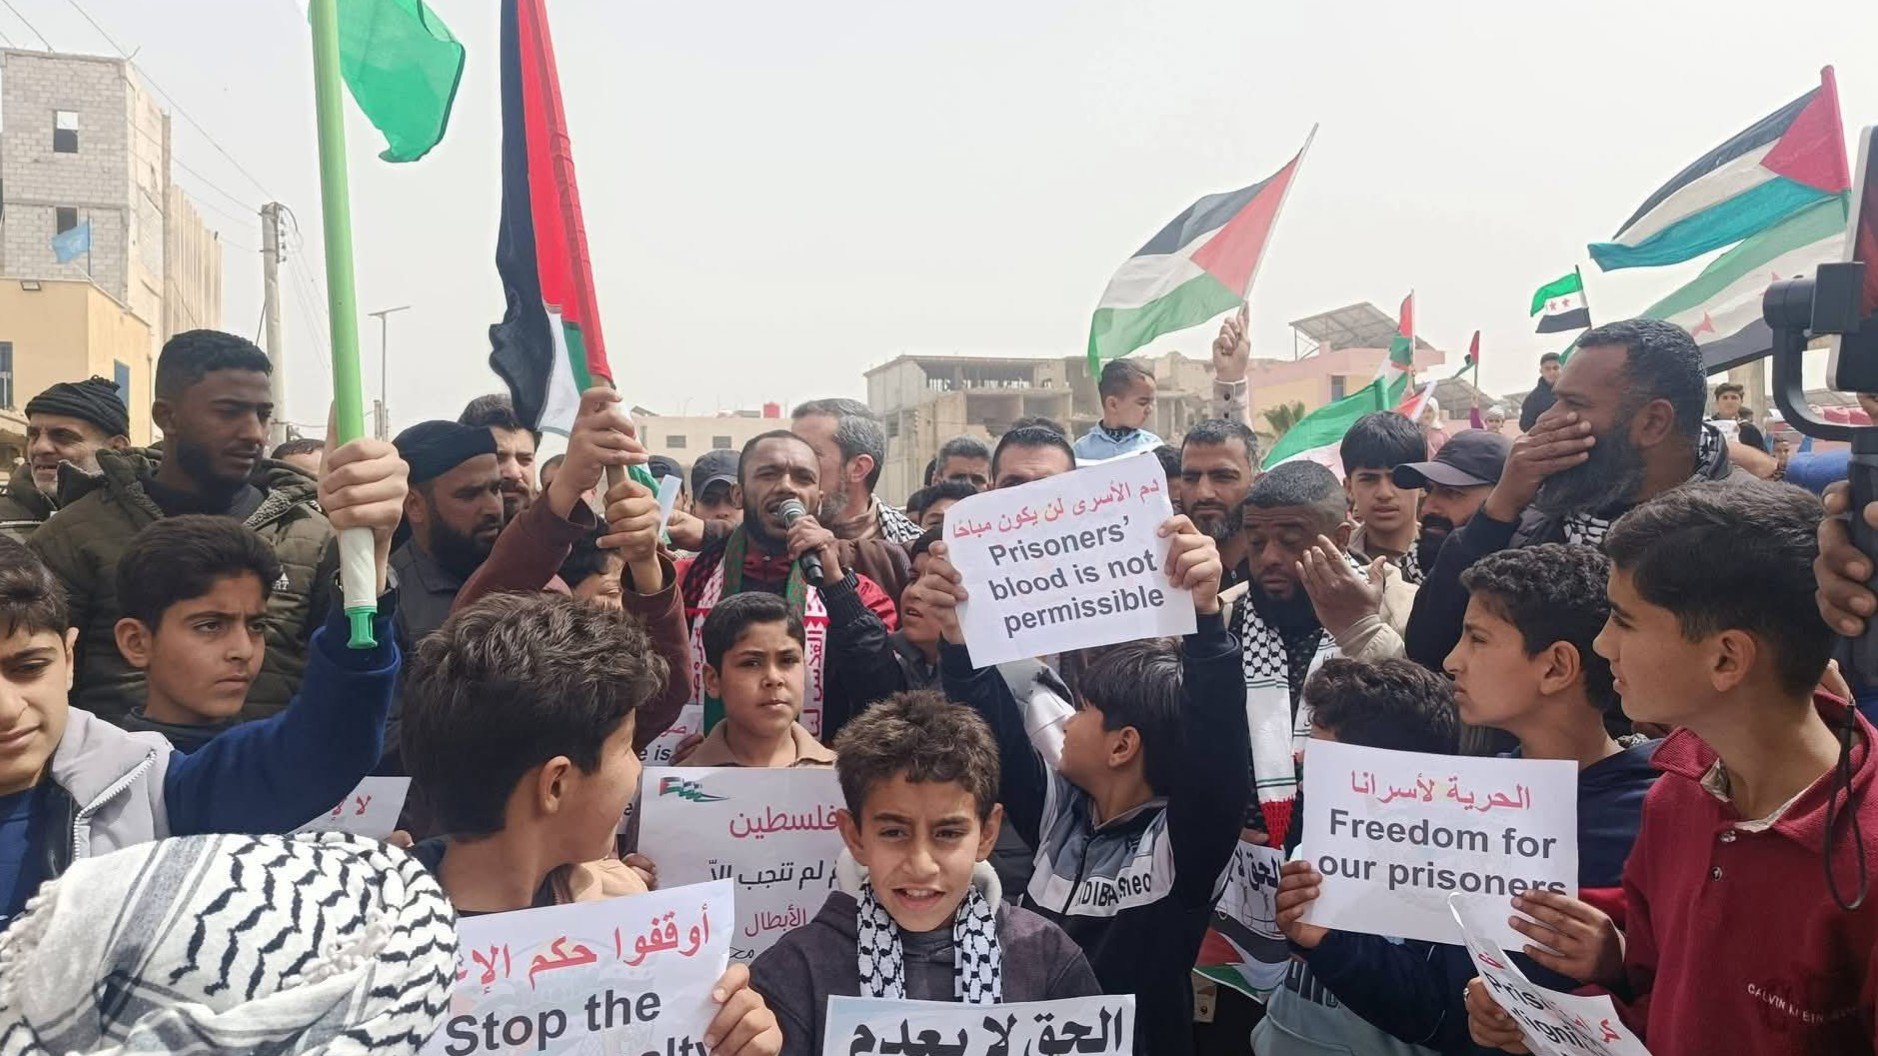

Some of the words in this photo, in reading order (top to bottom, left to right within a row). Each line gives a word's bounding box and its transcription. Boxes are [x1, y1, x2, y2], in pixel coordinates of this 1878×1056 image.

[1044, 498, 1064, 521] لن
[1072, 480, 1131, 515] الأسرى
[1138, 479, 1160, 504] دم
[998, 507, 1038, 532] يكون
[988, 567, 1068, 601] blood
[1073, 563, 1100, 585] is
[1107, 549, 1158, 580] not
[1003, 585, 1165, 638] permissible
[654, 744, 671, 761] is
[1352, 770, 1435, 803] لأسرانا
[1447, 774, 1530, 812] الحرية
[1330, 808, 1488, 853] Freedom
[1502, 828, 1557, 858] for
[1318, 855, 1376, 880] our
[1389, 862, 1566, 896] prisoners
[614, 903, 711, 966] أوقفوا
[528, 936, 597, 990] حكم
[445, 1006, 567, 1056] Stop
[584, 989, 661, 1032] the
